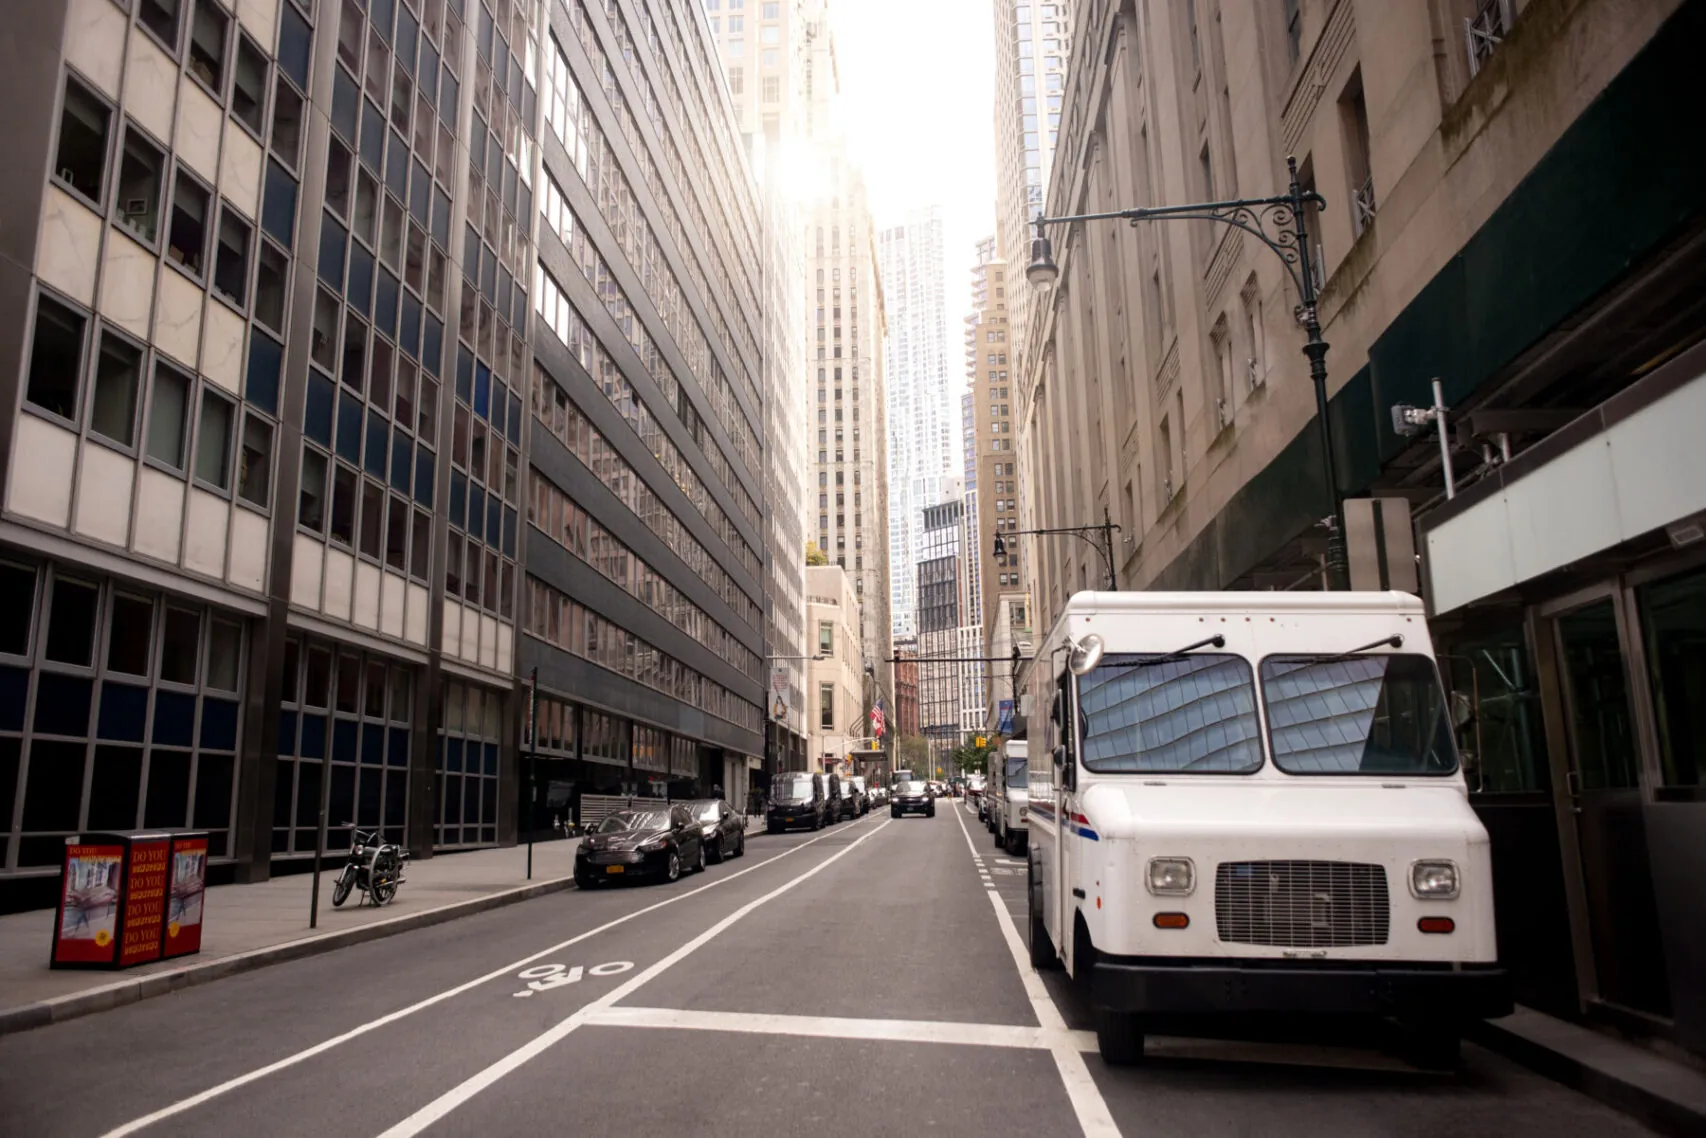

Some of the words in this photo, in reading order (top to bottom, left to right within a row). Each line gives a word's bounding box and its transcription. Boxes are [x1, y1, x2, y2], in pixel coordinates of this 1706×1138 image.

[133, 851, 147, 862] DO
[148, 849, 165, 861] YOU
[131, 877, 144, 889] DO
[146, 875, 163, 887] YOU
[143, 901, 160, 914] YOU
[141, 928, 158, 941] YOU
